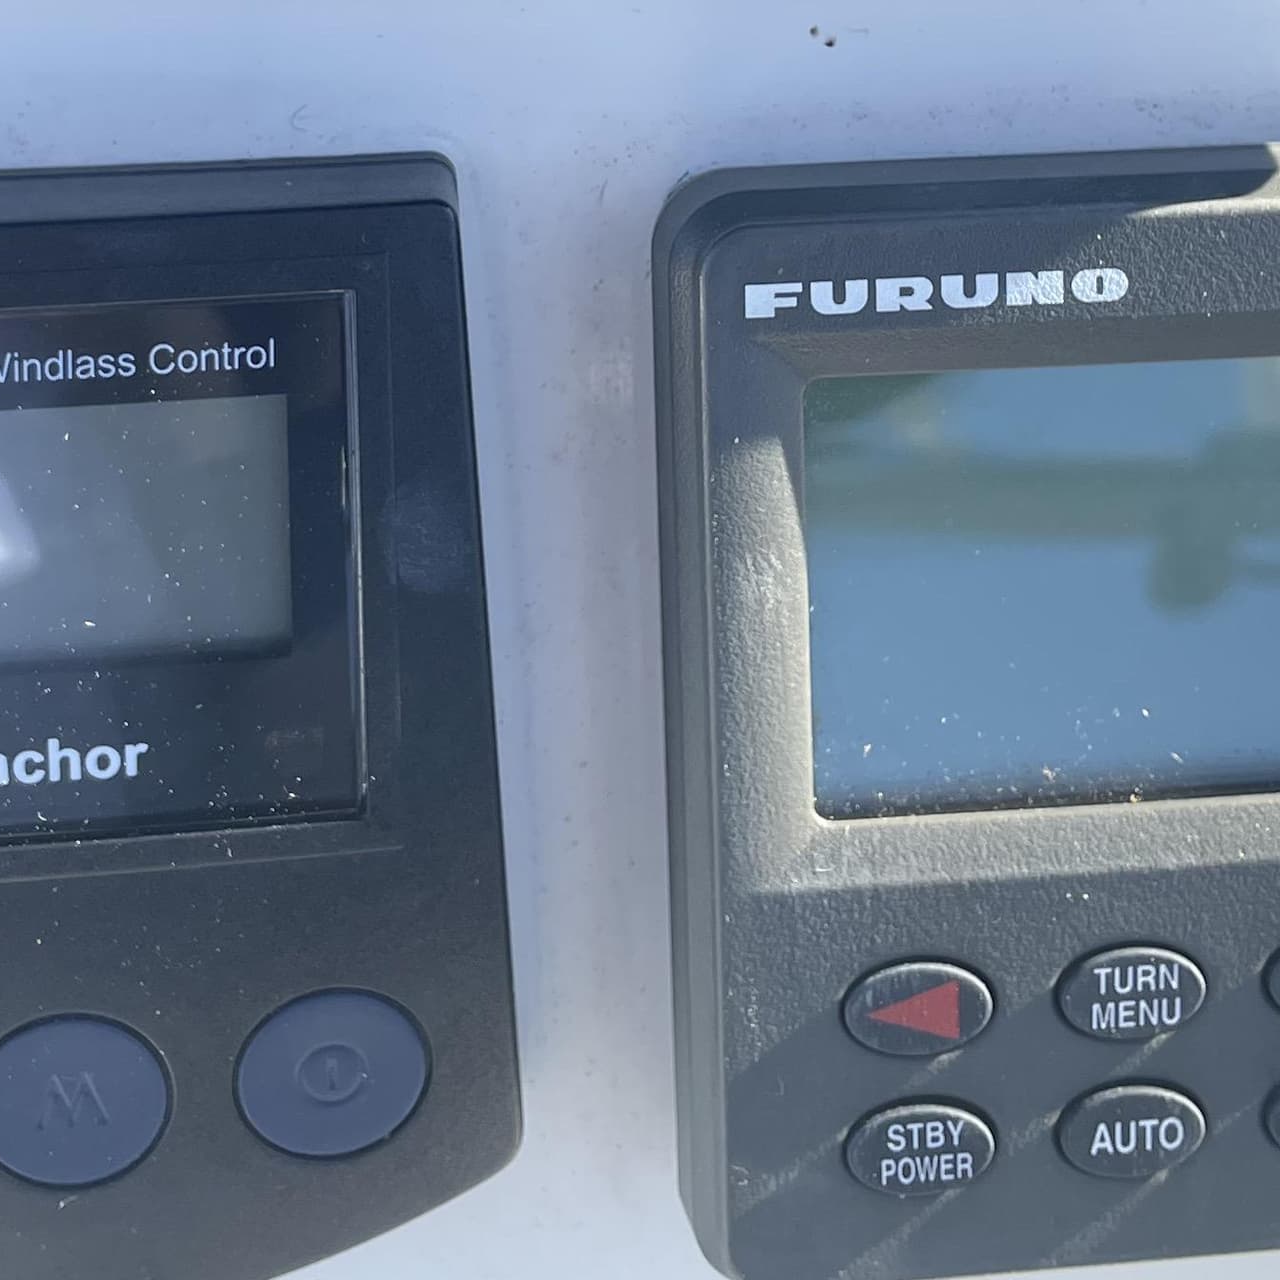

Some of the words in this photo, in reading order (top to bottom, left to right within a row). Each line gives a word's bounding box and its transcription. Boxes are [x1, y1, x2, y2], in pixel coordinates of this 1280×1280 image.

[744, 267, 1129, 319] FURUNO
[147, 337, 277, 376] Control
[1093, 963, 1180, 995] TURN
[1090, 997, 1182, 1030] MENU
[886, 1118, 965, 1151] STBY
[1090, 1116, 1185, 1156] AUTO
[880, 1151, 974, 1187] POWER
